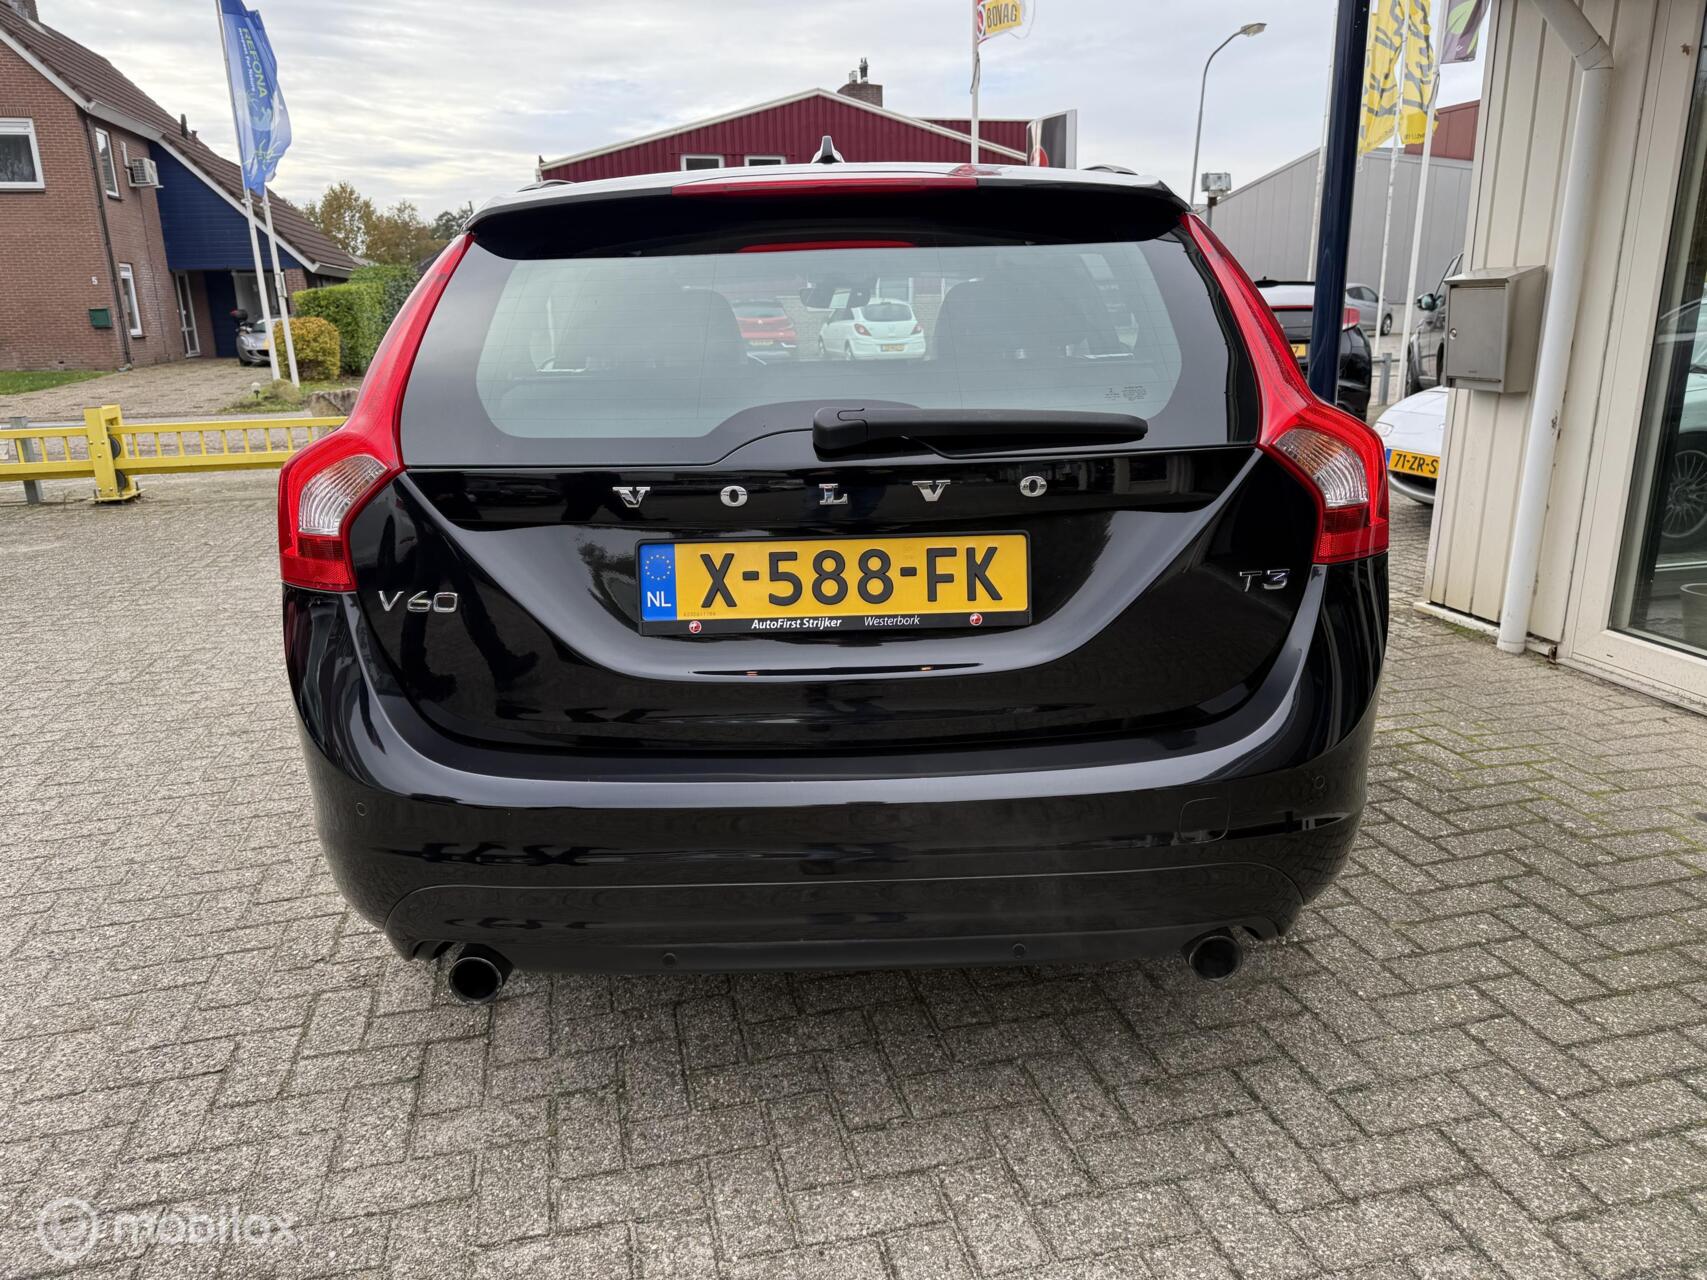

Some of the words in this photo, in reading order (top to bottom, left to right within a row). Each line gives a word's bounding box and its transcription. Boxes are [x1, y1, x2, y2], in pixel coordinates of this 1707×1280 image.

[986, 4, 1018, 29] BOVAG
[91, 276, 98, 285] 5
[1394, 453, 1439, 475] 71-ZR-S
[612, 475, 1048, 508] VOLVO
[700, 546, 1003, 608] X-588-FK
[1239, 568, 1291, 593] T3
[377, 590, 459, 613] V60
[646, 591, 672, 608] NL
[751, 618, 801, 630] AutoFirst
[802, 617, 843, 630] Strijker
[864, 615, 921, 626] Westerbork
